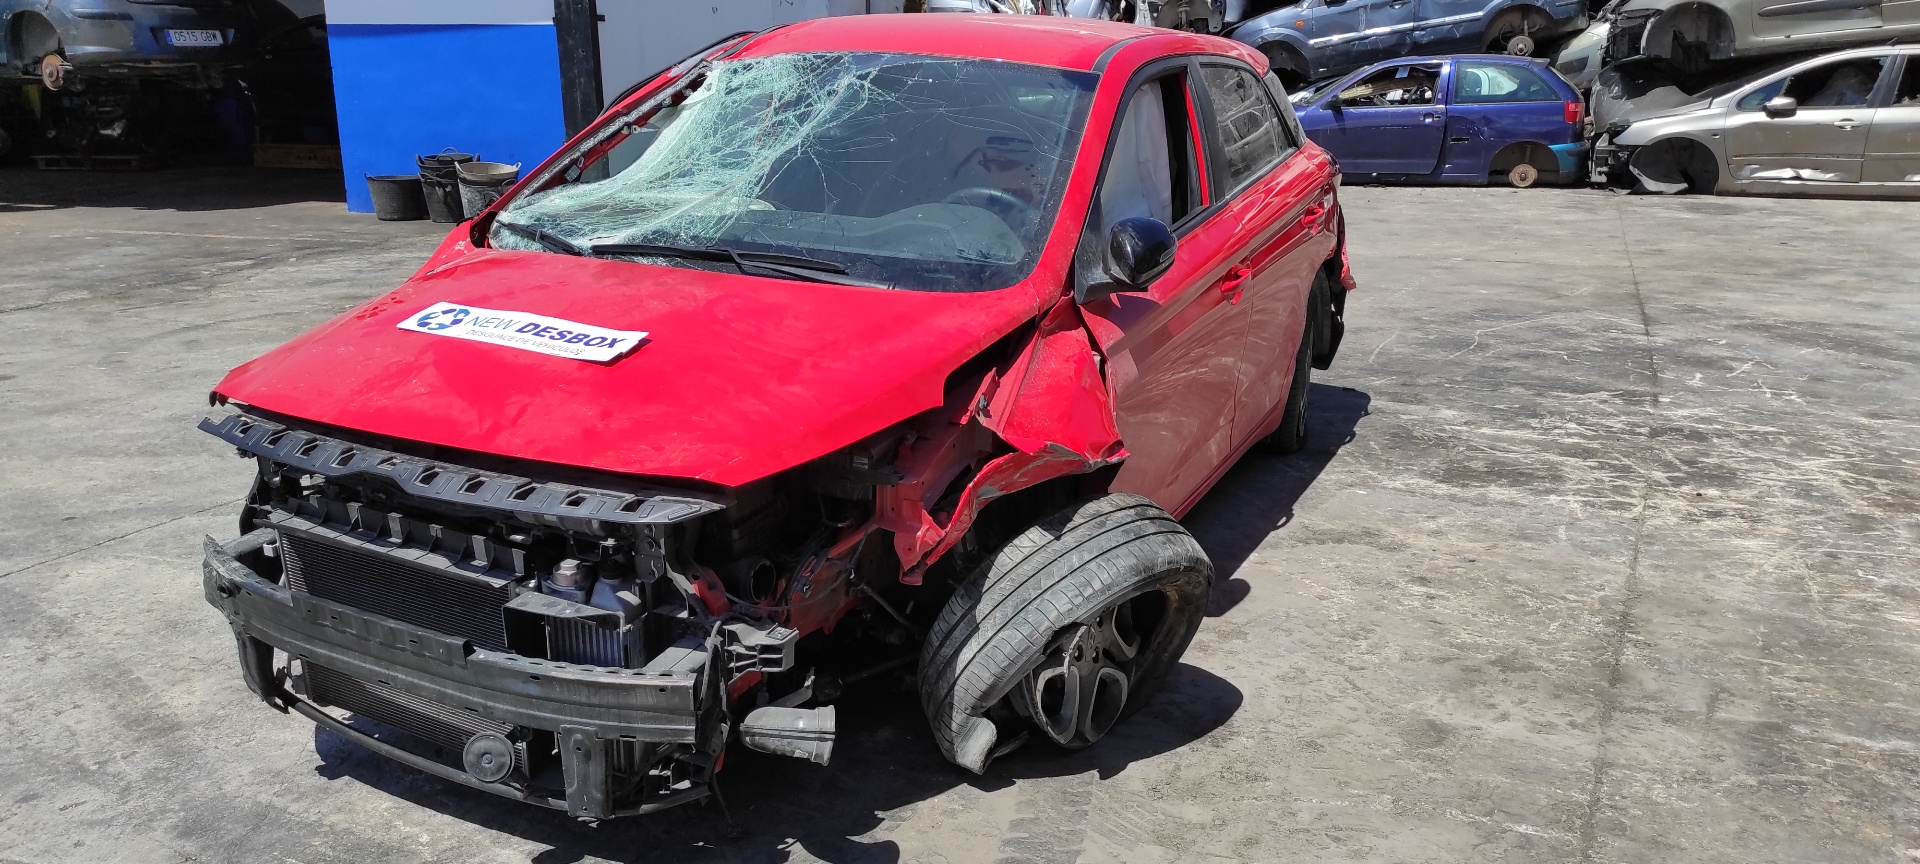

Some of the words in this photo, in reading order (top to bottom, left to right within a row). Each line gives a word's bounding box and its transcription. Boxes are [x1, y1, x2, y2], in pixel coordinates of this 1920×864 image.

[173, 31, 198, 42] 0515
[464, 316, 522, 330] NEW
[514, 322, 627, 349] DESBOX
[465, 329, 517, 342] DESGUACE
[515, 337, 532, 345] DE
